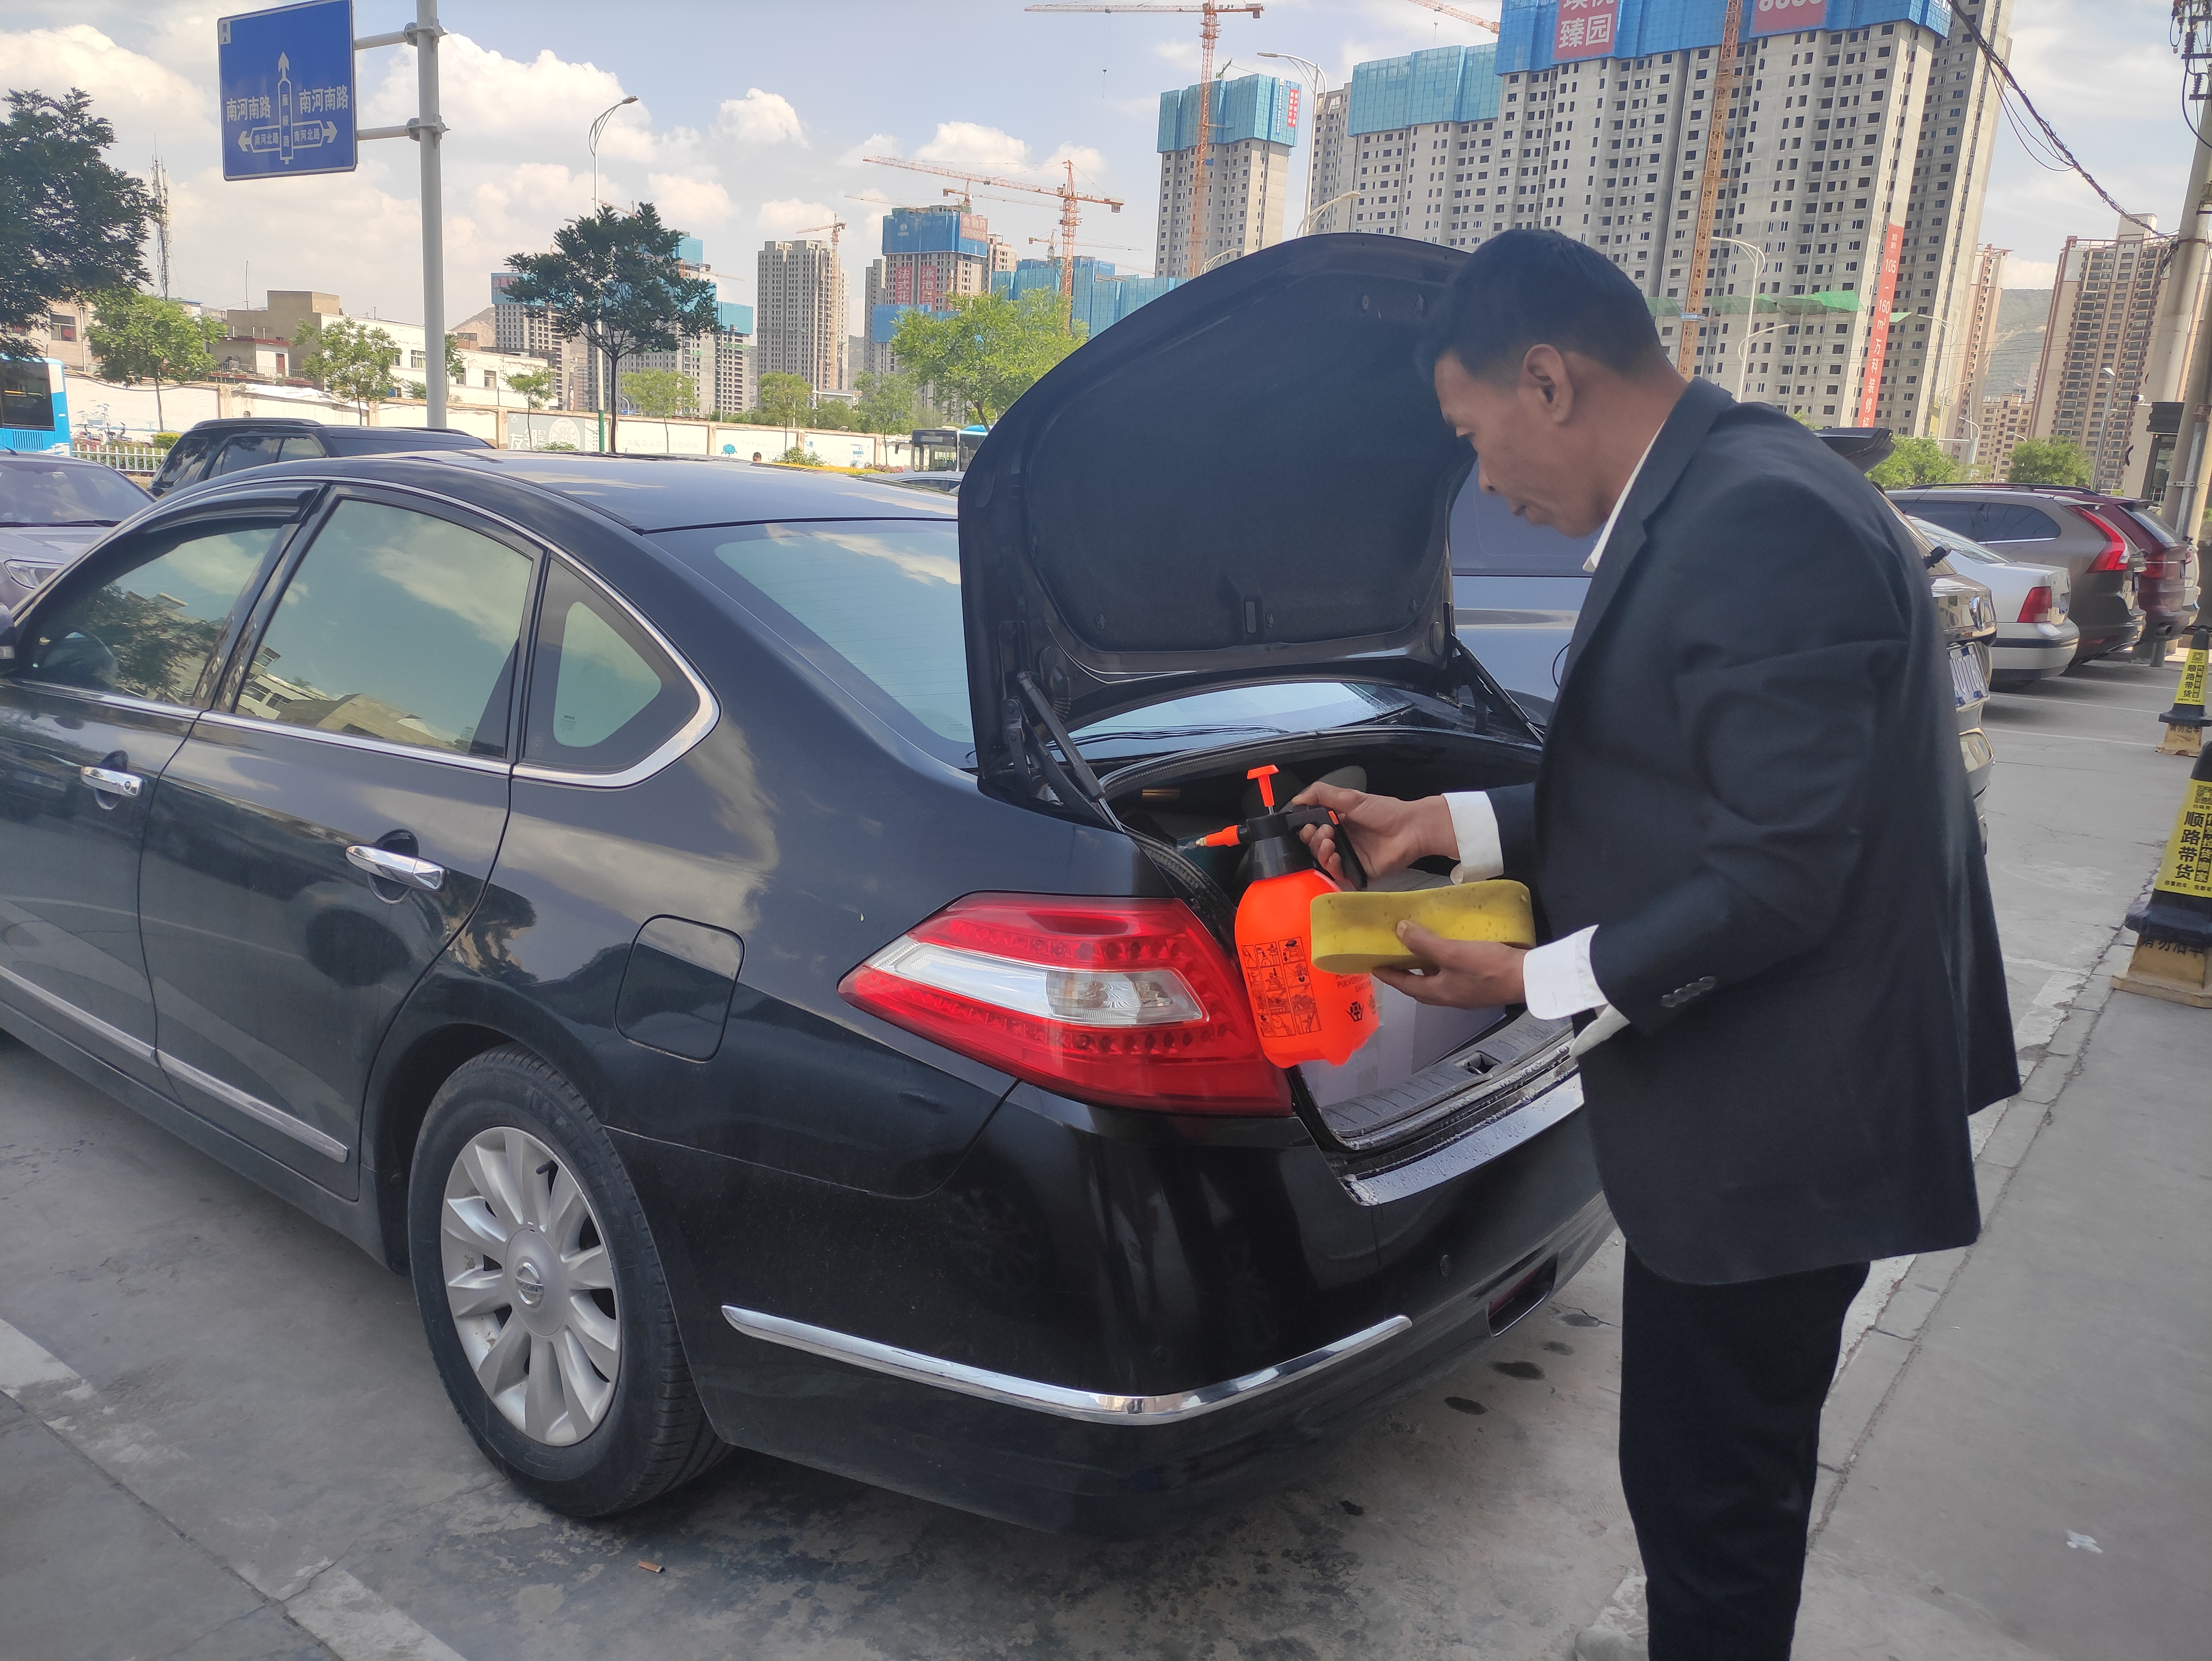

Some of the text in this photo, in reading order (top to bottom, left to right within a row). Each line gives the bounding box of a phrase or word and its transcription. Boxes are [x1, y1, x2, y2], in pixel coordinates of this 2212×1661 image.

[1559, 13, 1612, 48] 臻园
[226, 95, 271, 122] 南河南路
[299, 85, 349, 114] 南河南路
[254, 132, 279, 146] 南河北路
[294, 127, 320, 142] 南河北路
[1885, 258, 1897, 274] 105
[1879, 299, 1890, 314] 160
[2183, 664, 2197, 698] 顺路带货
[2175, 811, 2206, 880] 顺路带货
